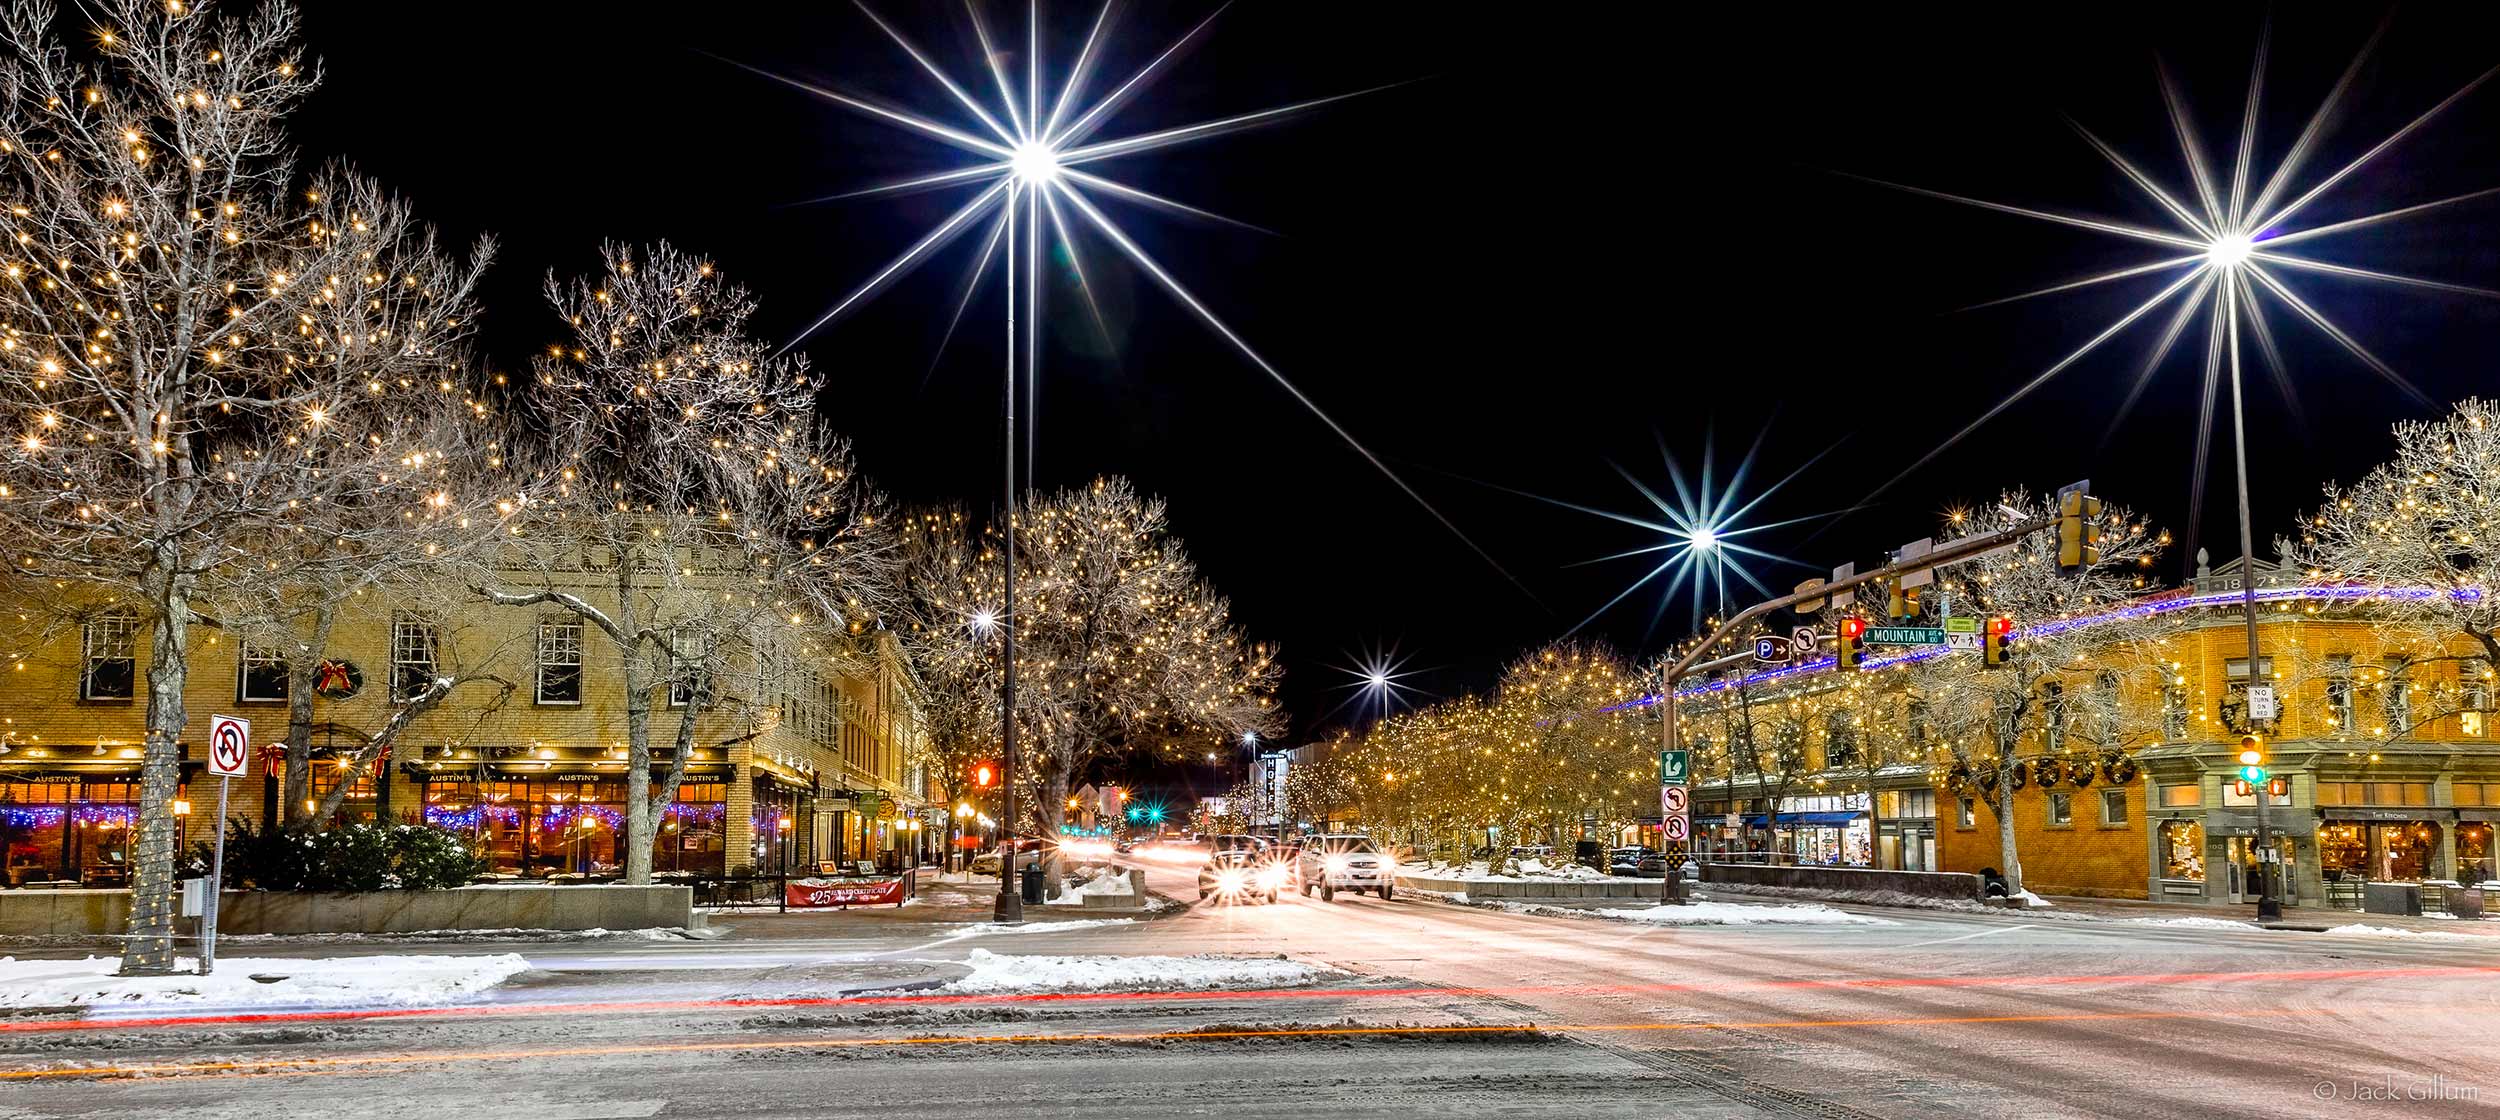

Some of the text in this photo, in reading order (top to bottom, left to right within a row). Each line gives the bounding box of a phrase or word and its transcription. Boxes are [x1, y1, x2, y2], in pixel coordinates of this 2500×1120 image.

[1874, 629, 1926, 642] MOUNTAIN
[1761, 642, 1771, 656] P
[1267, 758, 1276, 814] HOTE
[810, 889, 831, 905] $25
